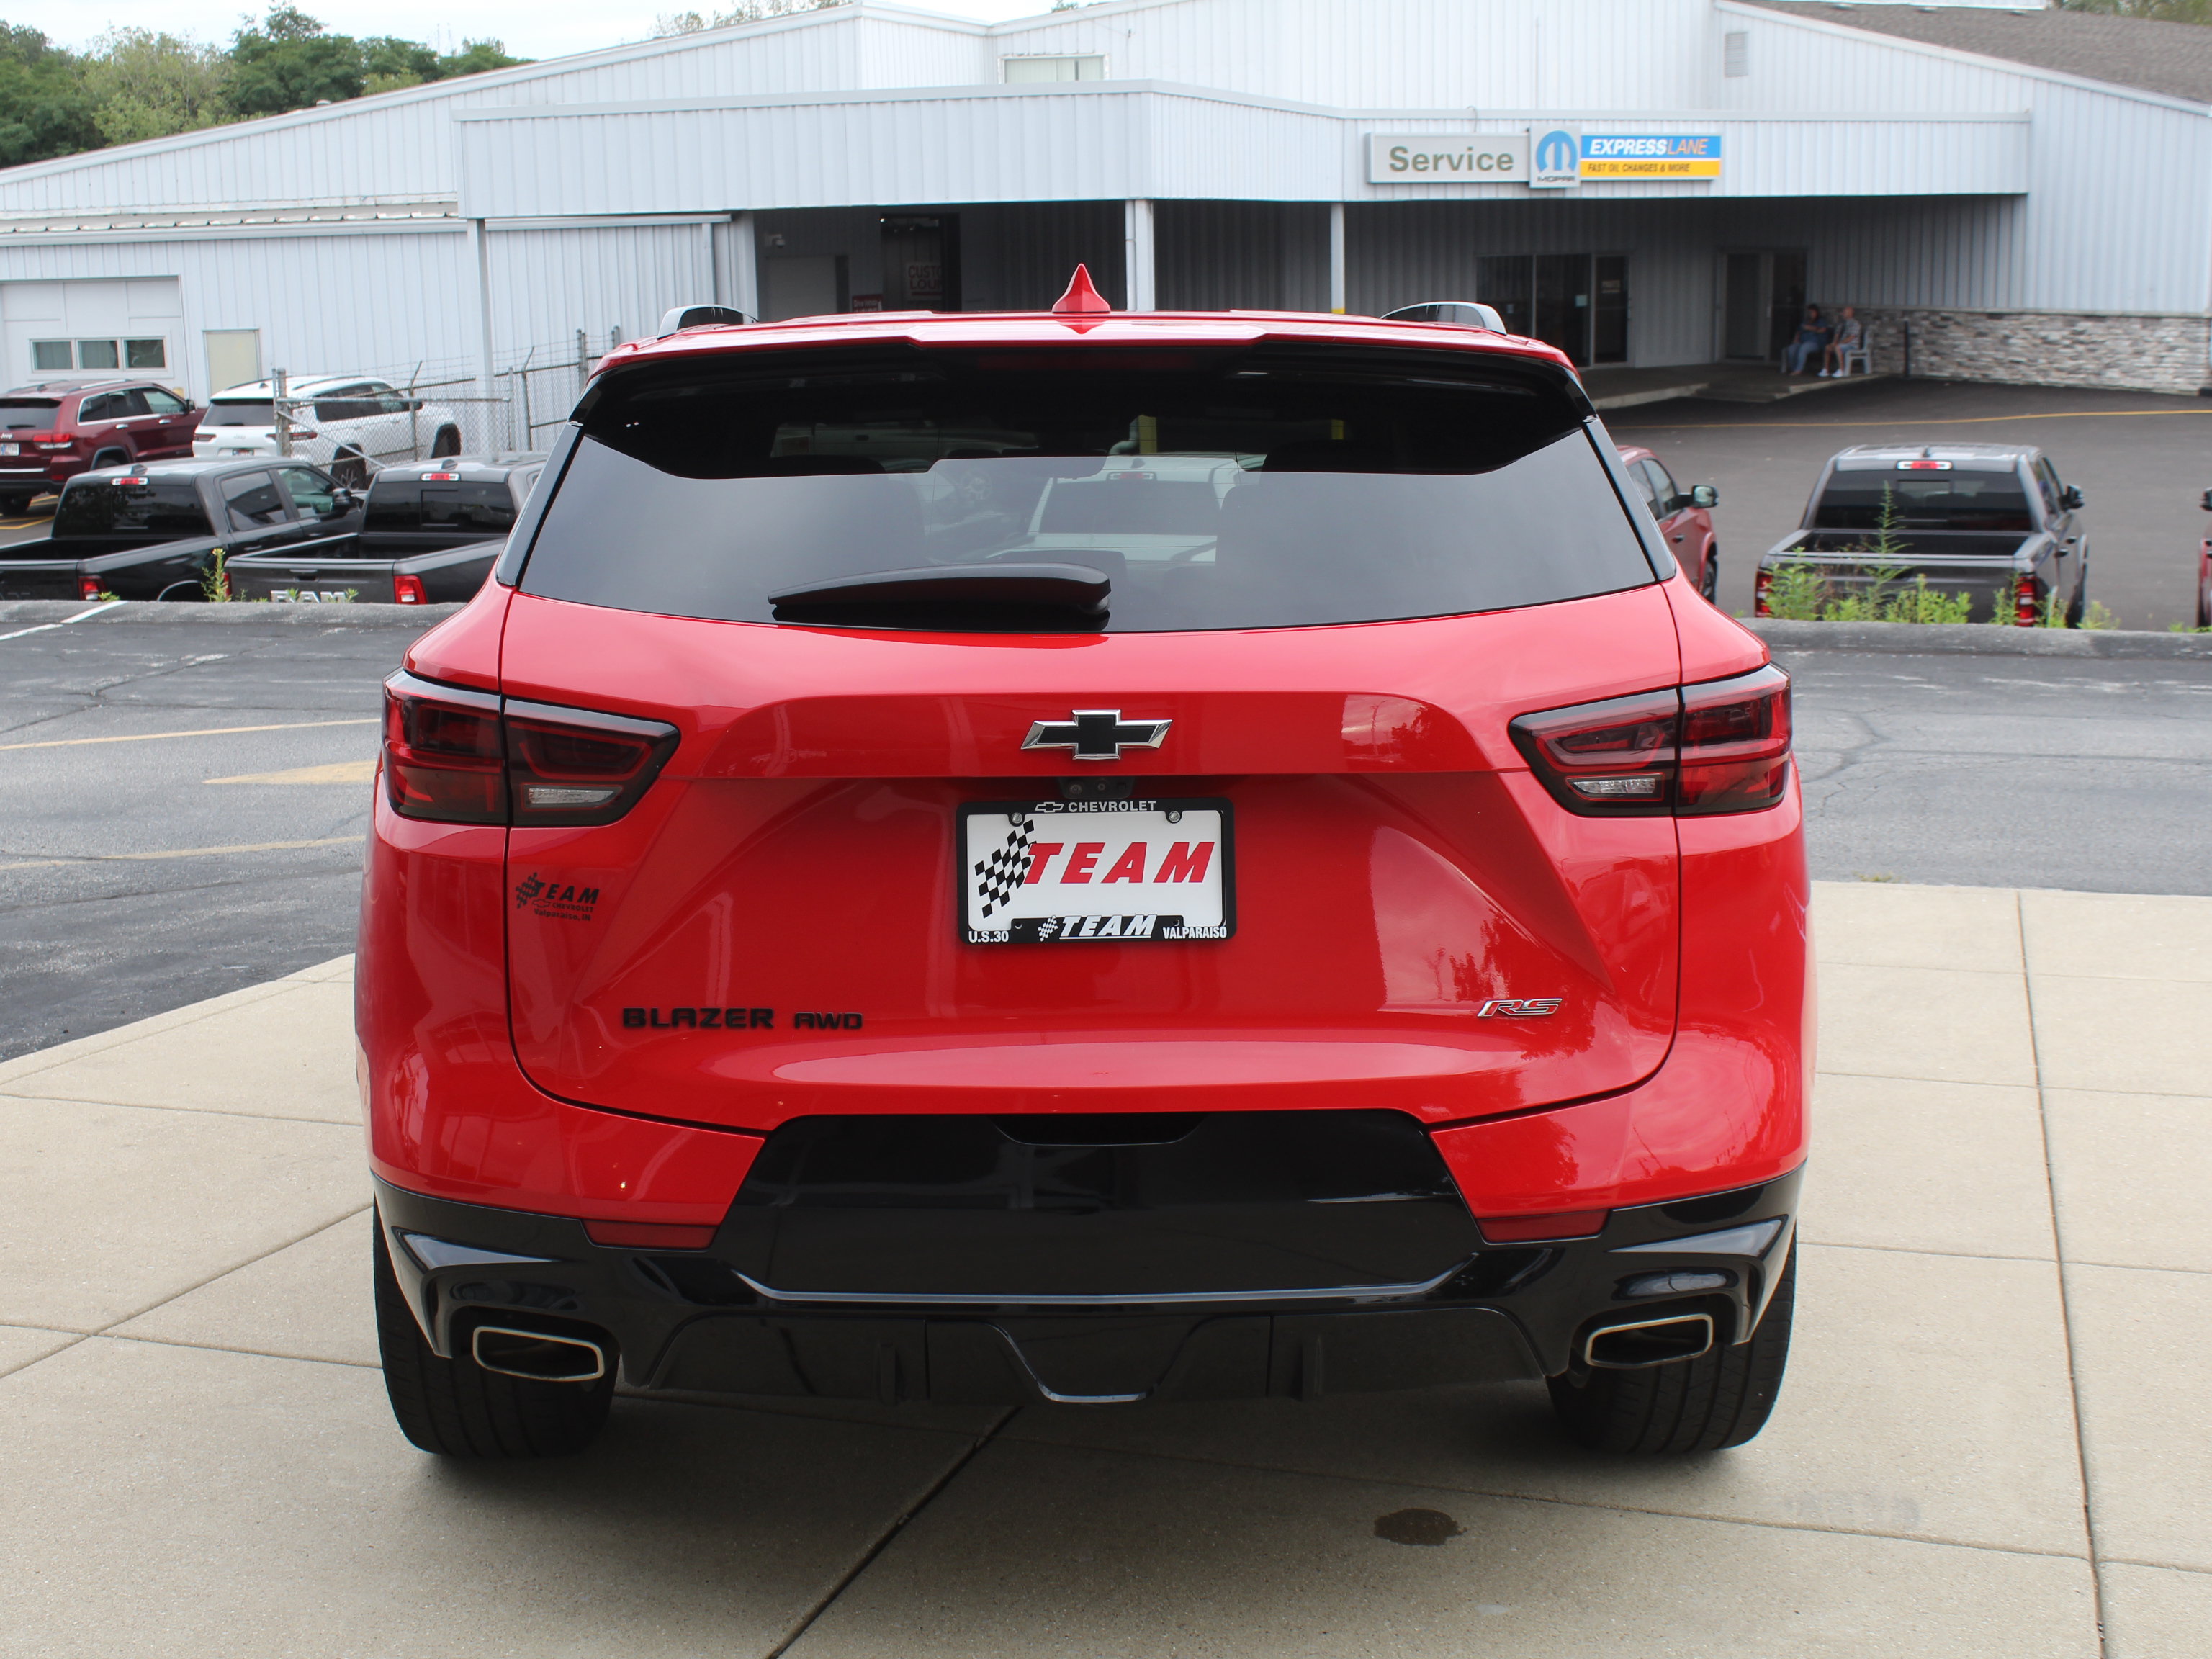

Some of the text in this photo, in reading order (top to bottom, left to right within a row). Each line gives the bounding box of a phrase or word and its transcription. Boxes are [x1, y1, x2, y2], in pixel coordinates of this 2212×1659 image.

[1389, 145, 1514, 171] Service
[1588, 163, 1690, 173] FAST OIL CHANGES & MORE
[271, 590, 347, 603] RAM
[1068, 800, 1156, 813] CHEVROLET
[1022, 842, 1215, 884] TEAM
[533, 881, 600, 904] TEAM
[552, 902, 594, 912] CHEVROLET
[1060, 914, 1158, 937] TEAM
[1162, 925, 1227, 940] VALPARAISO
[1477, 998, 1563, 1017] RS
[623, 1007, 863, 1030] BLAZER AWD
